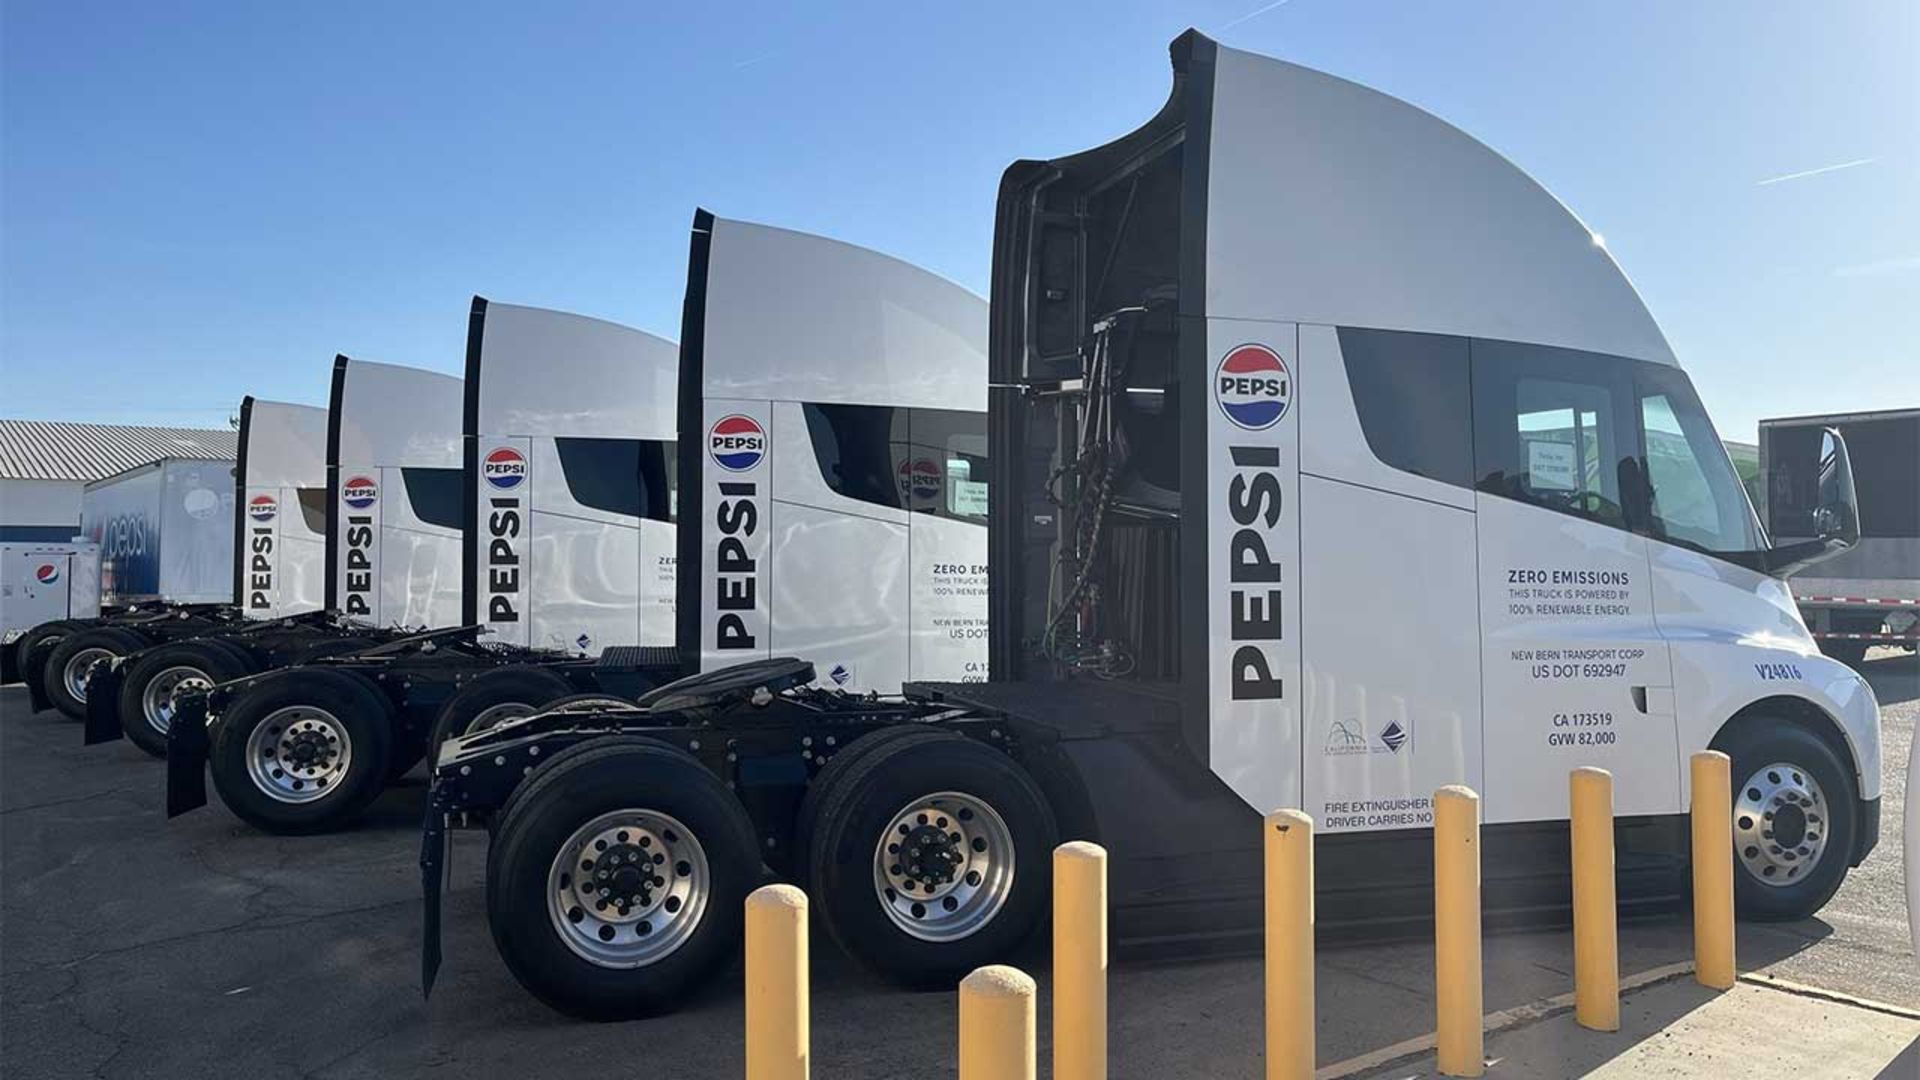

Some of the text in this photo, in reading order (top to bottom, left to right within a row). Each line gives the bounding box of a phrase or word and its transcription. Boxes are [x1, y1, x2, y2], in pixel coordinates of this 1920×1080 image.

[1221, 377, 1286, 397] PEPSI
[713, 436, 763, 450] PEPSI
[486, 464, 524, 474] PEPSI
[345, 489, 376, 497] PEPSI
[347, 516, 373, 615] PEPSI
[489, 498, 520, 622] PEPSI
[659, 557, 677, 565] ZER
[717, 482, 758, 650] PEPSI
[251, 528, 273, 609] PEPSI
[933, 564, 967, 574] ZERO
[1229, 446, 1283, 701] PEPSI
[1508, 570, 1629, 585] ZERO EMISSIONS
[1509, 588, 1629, 600] THIS TRUCK IS POWERED BY
[1509, 604, 1533, 615] 100%
[1536, 604, 1592, 615] RENEWABLE
[950, 629, 964, 639] US
[1511, 649, 1645, 661] NEW BERN TRANSPORT CORP
[965, 662, 978, 672] CA
[1532, 663, 1626, 678] US DOT 692947
[1754, 663, 1802, 680] V24816
[1553, 712, 1612, 727] CA 173519
[1548, 731, 1616, 746] GVW 82,000
[1325, 802, 1349, 813] FIRE
[1352, 798, 1429, 813] EXTINGUISHER
[1326, 812, 1433, 828] DRIVER CARRIES NO
